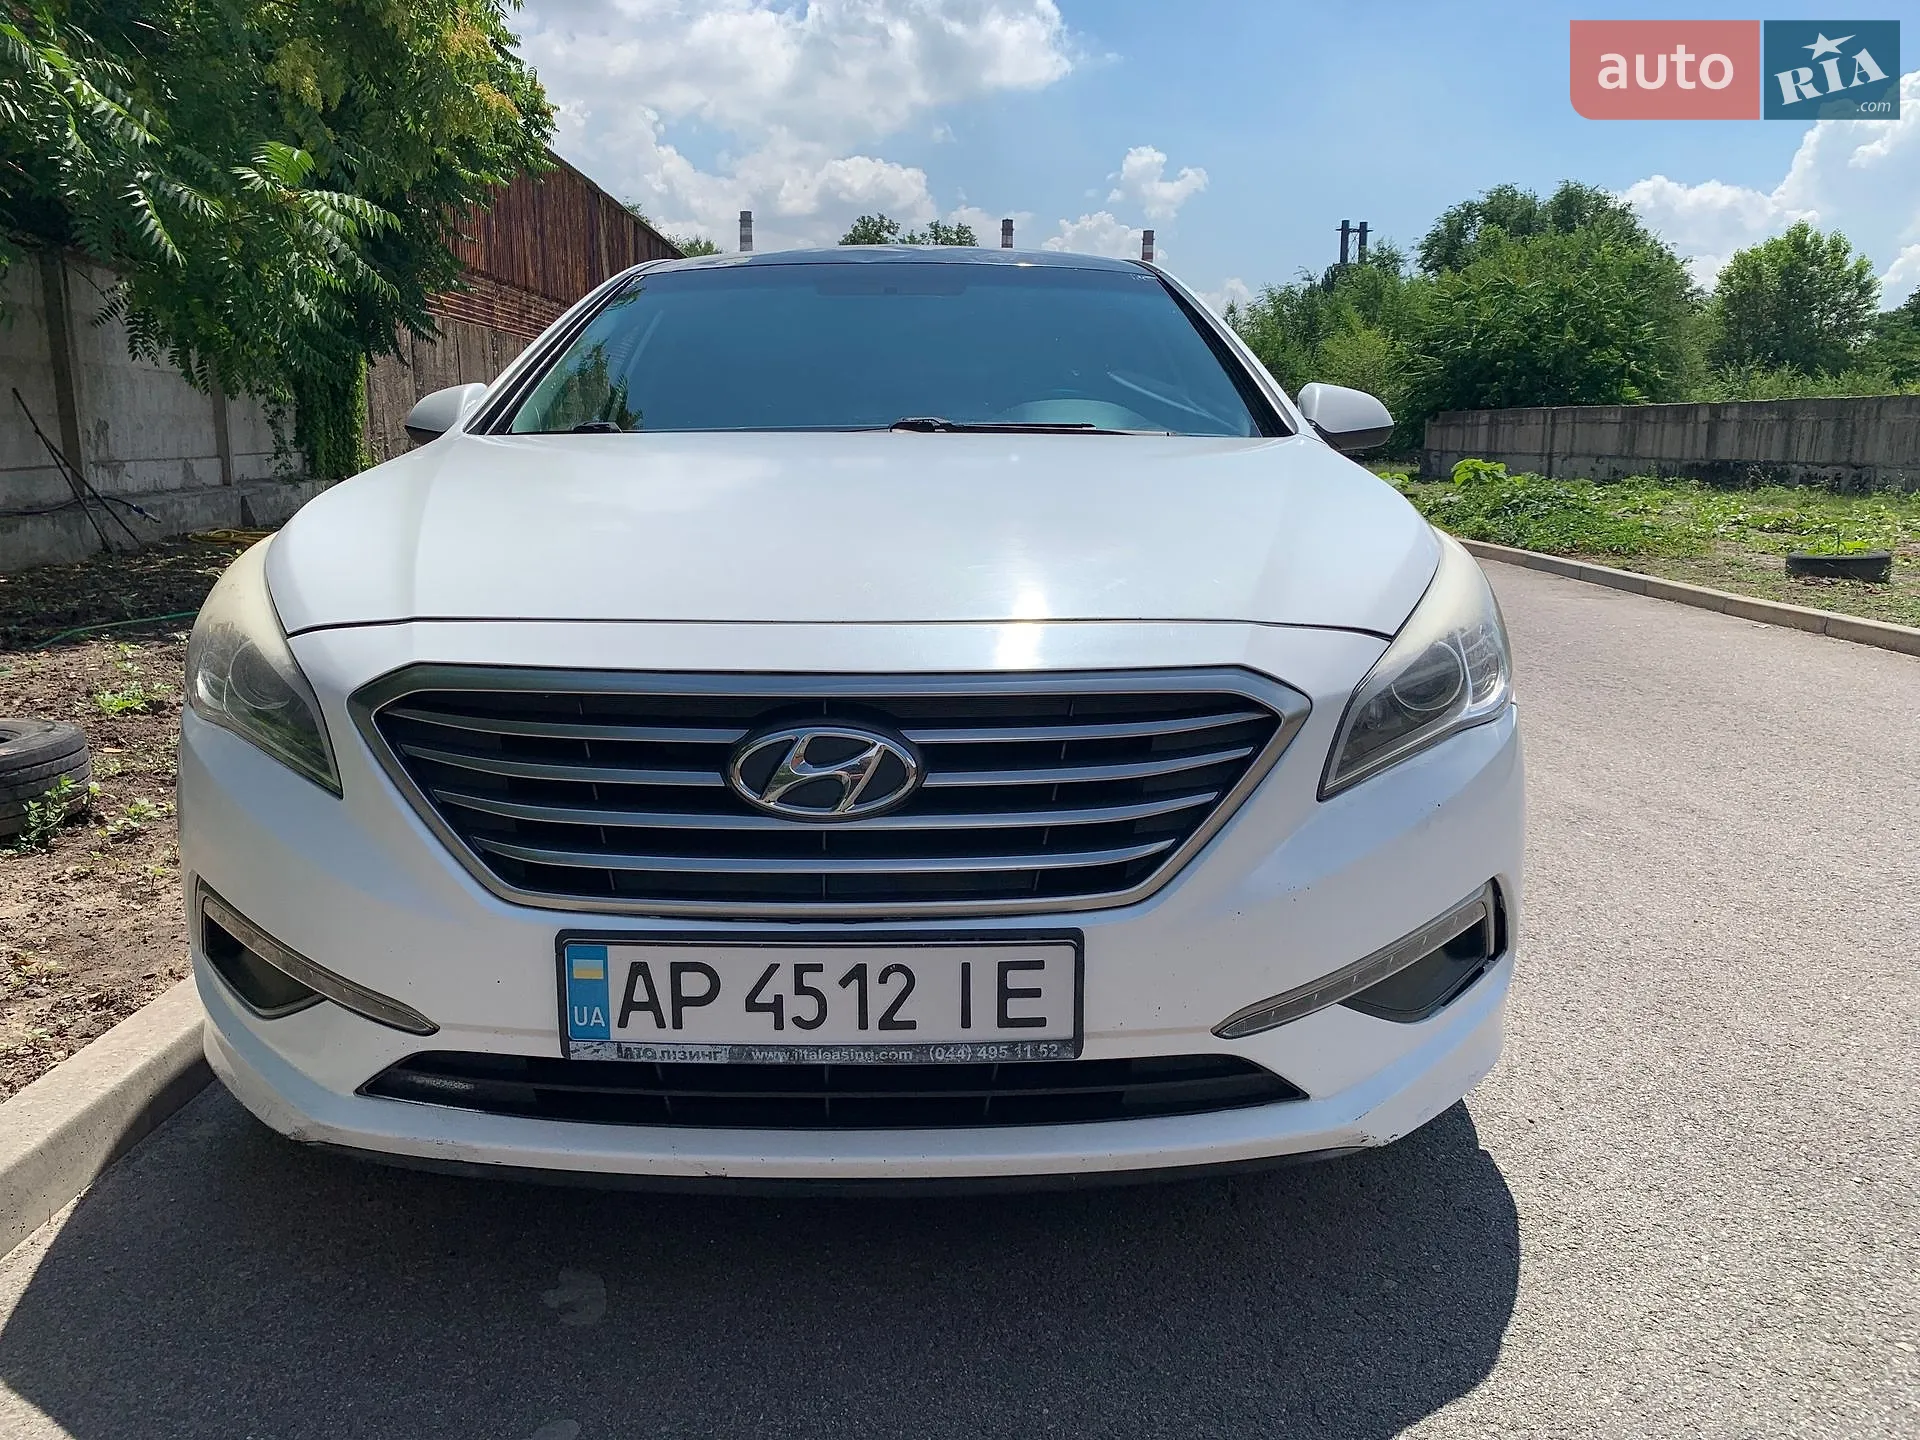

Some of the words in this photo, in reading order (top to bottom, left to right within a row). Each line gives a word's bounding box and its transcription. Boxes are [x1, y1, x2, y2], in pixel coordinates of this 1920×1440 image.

[617, 961, 721, 1030] AP
[745, 963, 917, 1030] 4512
[960, 960, 1047, 1029] IE
[574, 1006, 606, 1027] UA
[929, 1044, 972, 1062] (044)
[977, 1044, 1008, 1059] 495
